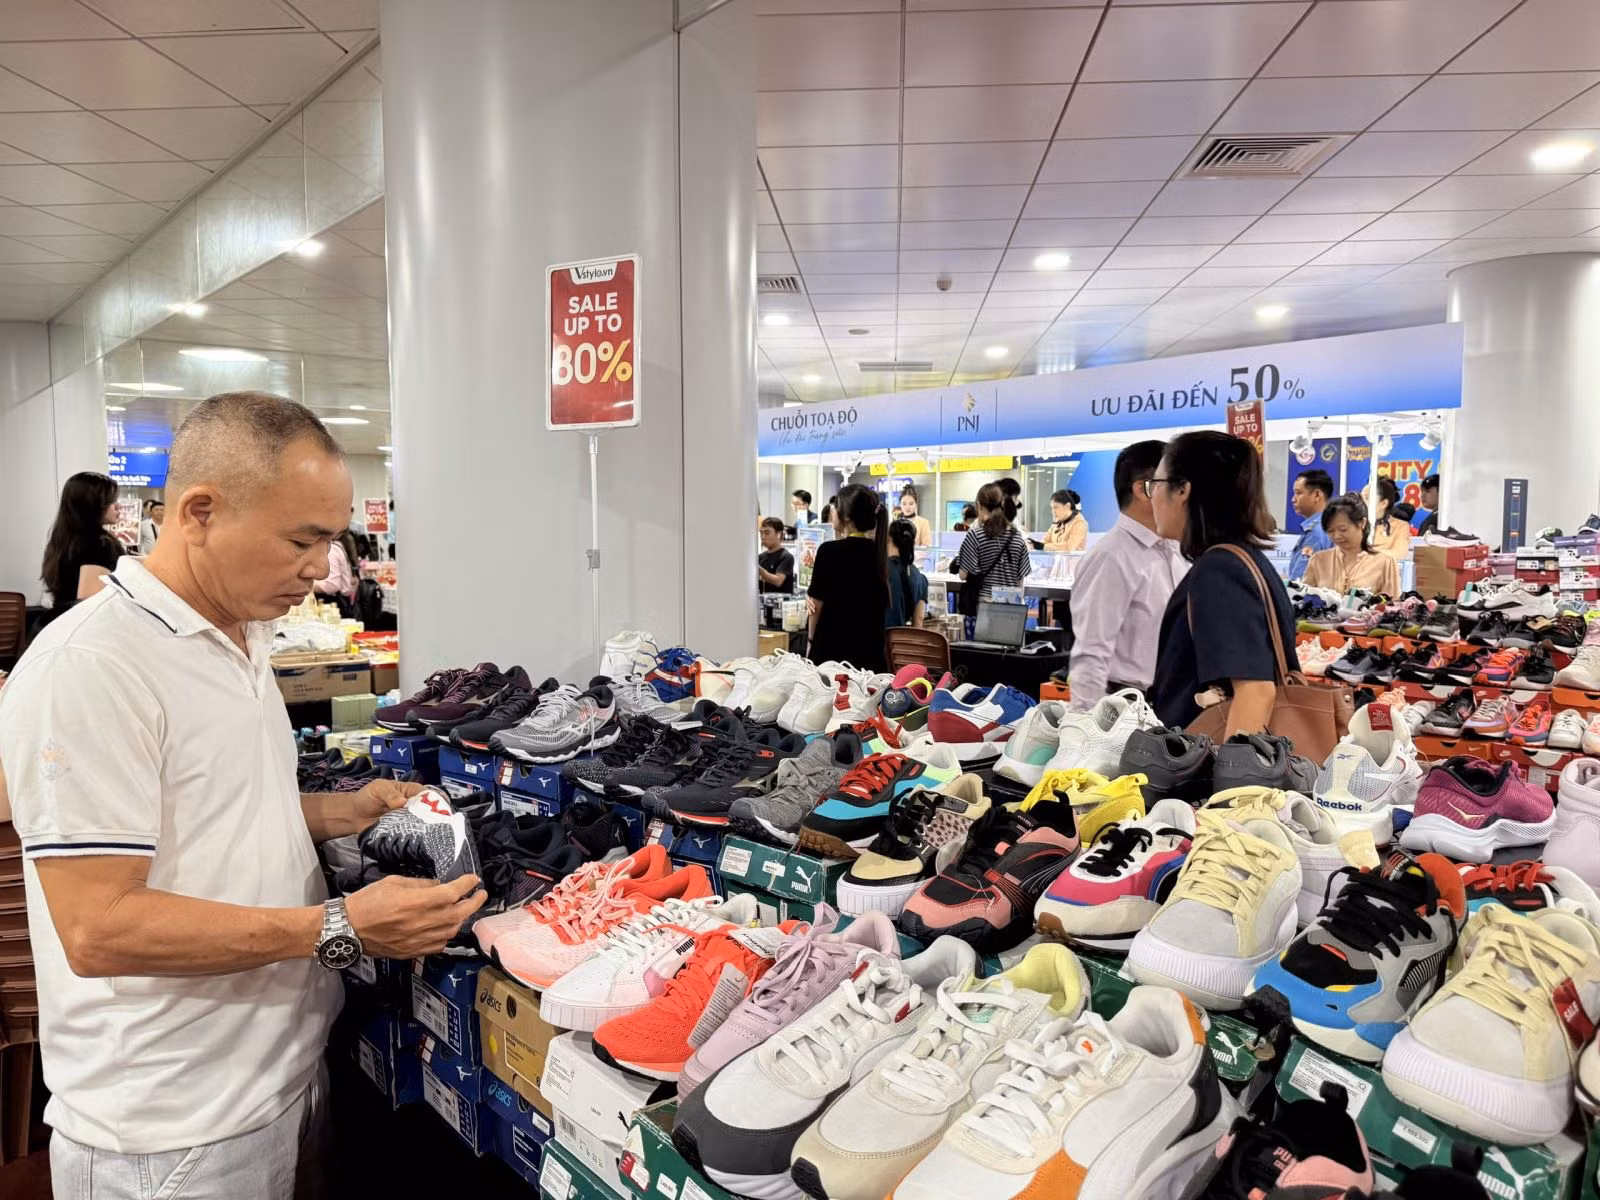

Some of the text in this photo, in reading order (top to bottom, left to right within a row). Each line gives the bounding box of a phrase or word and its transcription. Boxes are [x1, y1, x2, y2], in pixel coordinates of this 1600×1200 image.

[568, 292, 618, 314] SALE
[564, 313, 622, 336] UP TO
[552, 339, 633, 386] 80%
[1091, 396, 1121, 417] ƯU
[1127, 389, 1165, 413] ĐÃI
[1171, 380, 1218, 409] ĐẾN
[810, 412, 835, 430] TOẠ
[837, 405, 858, 427] ĐỘ
[957, 414, 980, 433] PNJ
[1234, 413, 1256, 425] SALE
[1233, 423, 1258, 435] UP TO
[1378, 460, 1432, 482] CITY
[1317, 797, 1362, 811] Reebok
[1210, 1047, 1233, 1065] UMA
